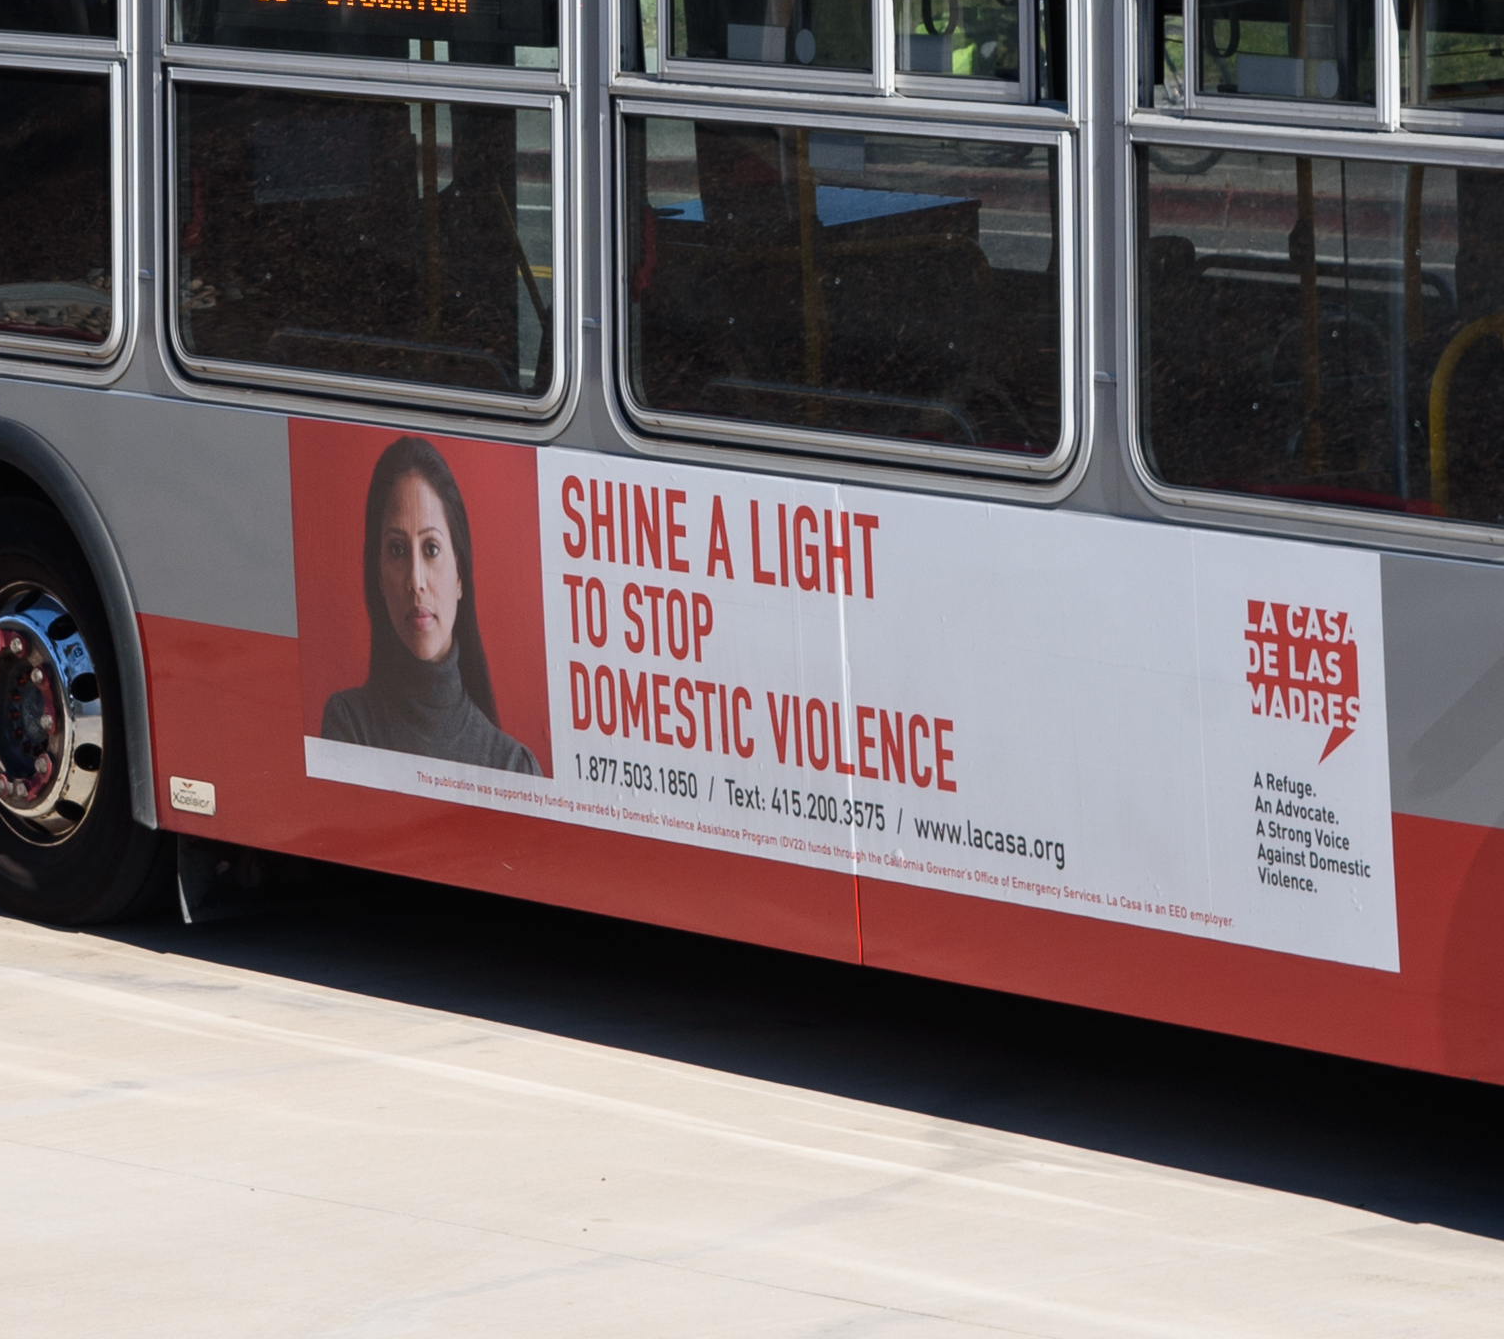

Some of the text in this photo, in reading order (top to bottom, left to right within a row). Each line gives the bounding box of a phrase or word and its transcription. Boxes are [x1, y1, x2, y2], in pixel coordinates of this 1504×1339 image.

[560, 474, 880, 600] SHINE A LIGHT
[562, 573, 714, 663] TO STOP
[1244, 600, 1358, 646] LA CASA
[1245, 639, 1343, 686] DE LAS
[569, 660, 958, 793] DOMESTIC VIOLENCE
[1246, 681, 1361, 731] MADRES
[1253, 771, 1317, 799] A Refuge.
[575, 752, 1066, 871] 1.877.503.1850 / Text: 415.200.3575 / www.lacasa.org
[1255, 795, 1340, 825] An Advocate.
[417, 770, 433, 783] This
[434, 777, 476, 792] publication
[477, 785, 492, 796] was
[494, 786, 533, 803] supported
[534, 792, 543, 806] by
[545, 794, 574, 812] funding
[576, 800, 609, 816] awarded
[611, 805, 621, 821] by
[623, 808, 660, 825] Domestic
[661, 814, 695, 832] Violence
[697, 821, 740, 839] Assistance
[742, 828, 778, 847] Program
[780, 836, 807, 852] (DV22)
[808, 840, 832, 856] funds
[833, 845, 866, 864] through
[868, 851, 882, 865] the
[884, 853, 924, 873] California
[974, 870, 999, 886] Office
[1000, 874, 1010, 888] of
[1012, 877, 1062, 899] Emergency
[1106, 893, 1118, 907] La
[1120, 896, 1143, 912] Casa
[1144, 900, 1153, 913] is
[1155, 903, 1167, 916] an
[1169, 904, 1188, 919] EEO
[1190, 910, 1236, 929] employer.
[1256, 819, 1350, 851] A Strong Voice
[1257, 843, 1372, 878] Against Domestic
[1258, 866, 1318, 893] Violence.
